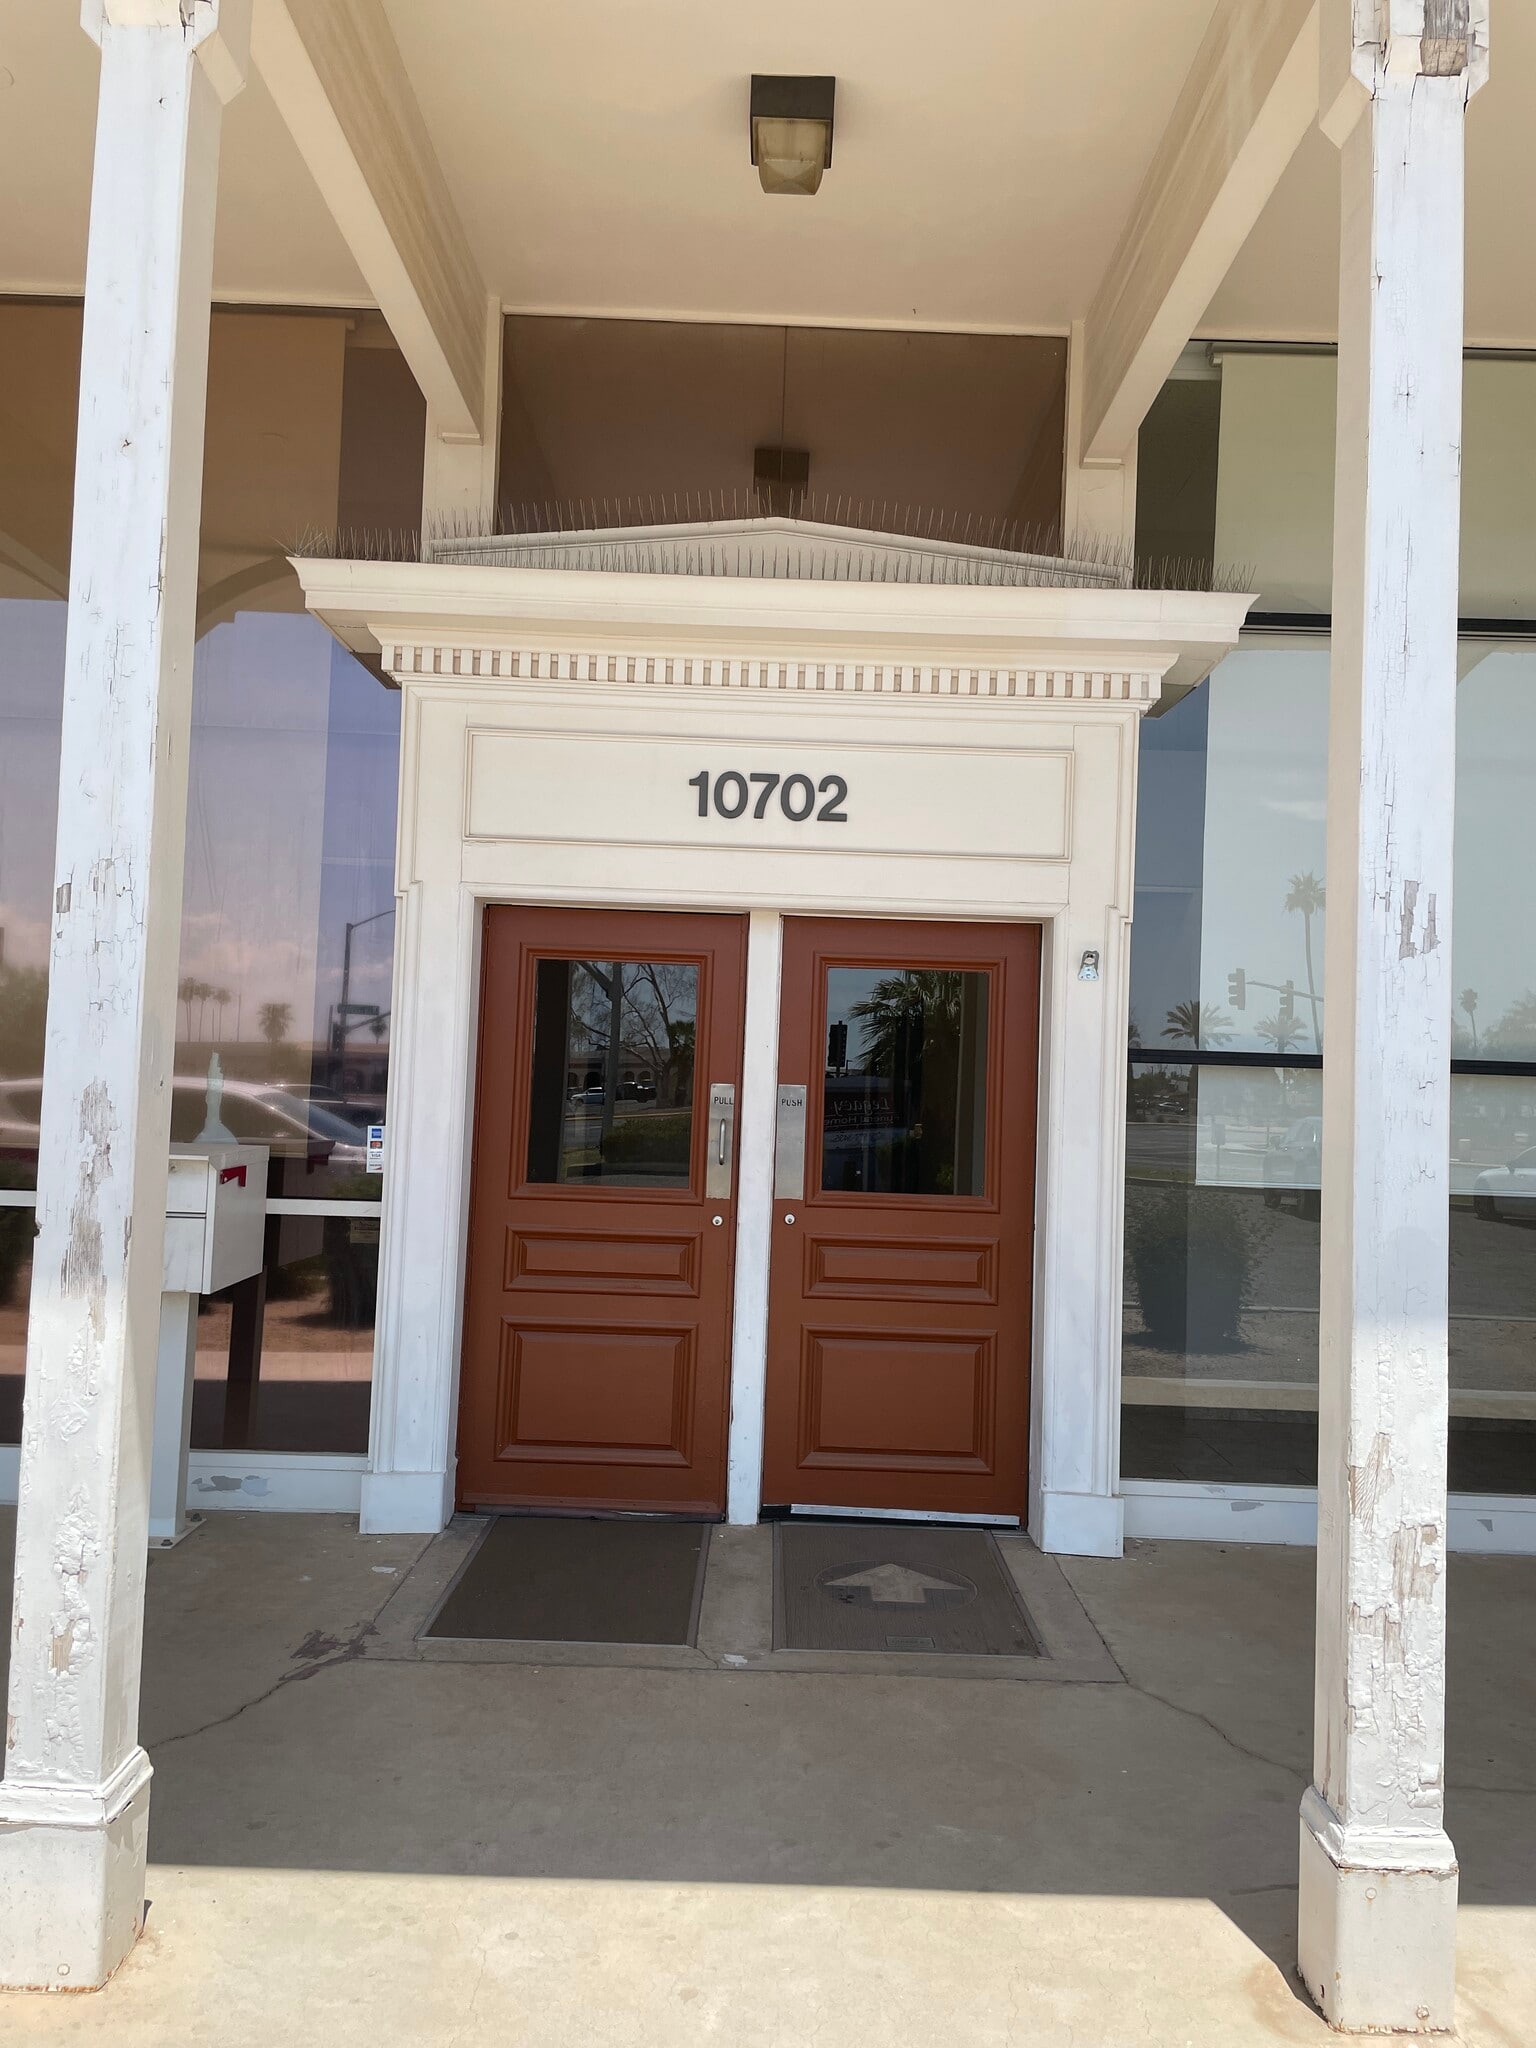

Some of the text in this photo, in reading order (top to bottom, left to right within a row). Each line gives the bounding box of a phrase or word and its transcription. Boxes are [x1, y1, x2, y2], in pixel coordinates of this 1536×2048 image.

[689, 771, 848, 822] 10702
[713, 1096, 734, 1105] PULL
[781, 1098, 803, 1107] PUSH
